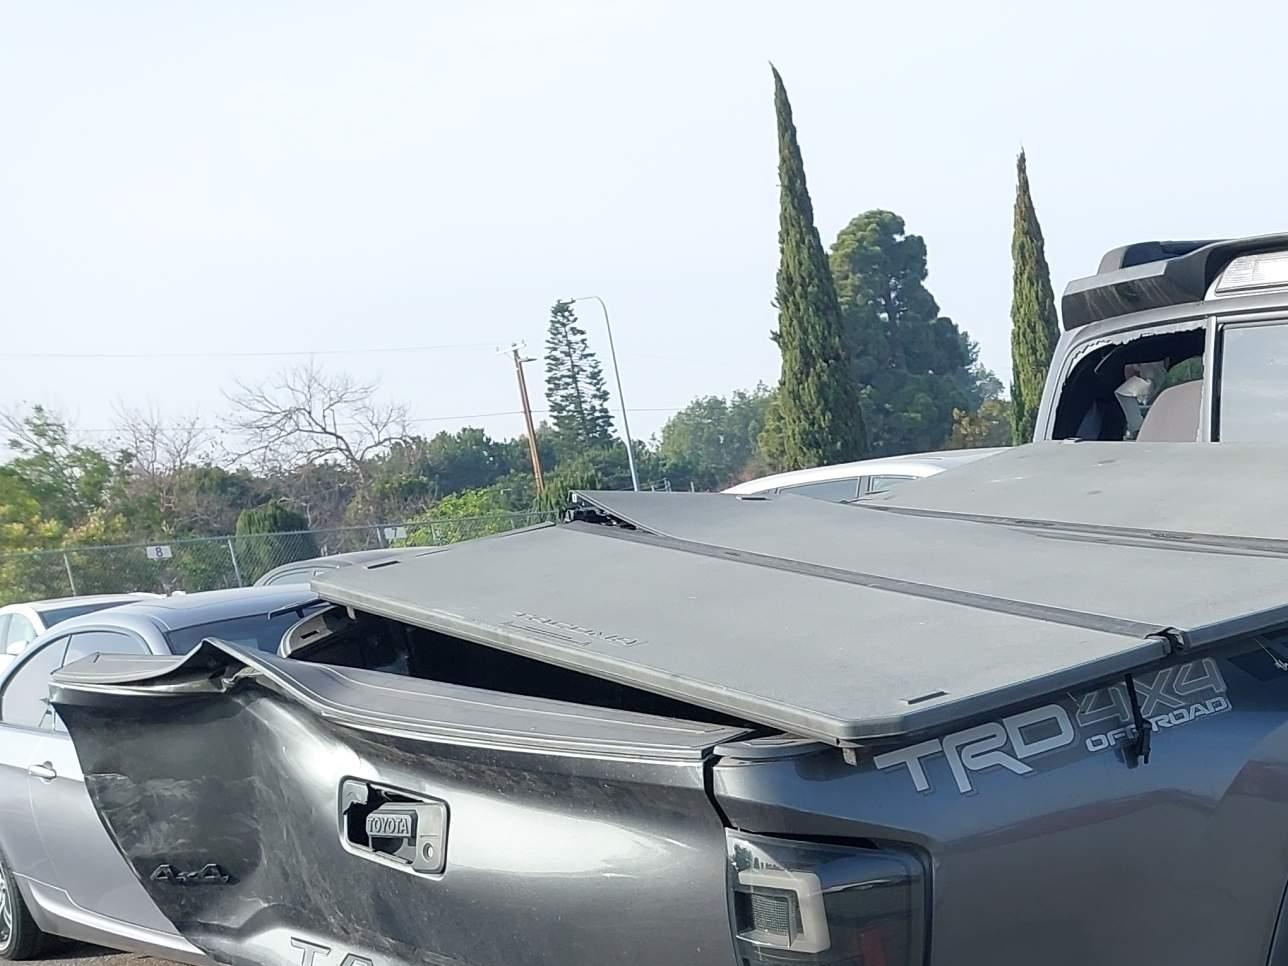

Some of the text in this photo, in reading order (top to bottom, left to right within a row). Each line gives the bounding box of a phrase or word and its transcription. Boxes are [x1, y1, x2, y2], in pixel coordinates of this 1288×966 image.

[1150, 696, 1230, 732] ROAD
[873, 703, 1076, 794] TRD
[367, 817, 410, 834] TOYOTA
